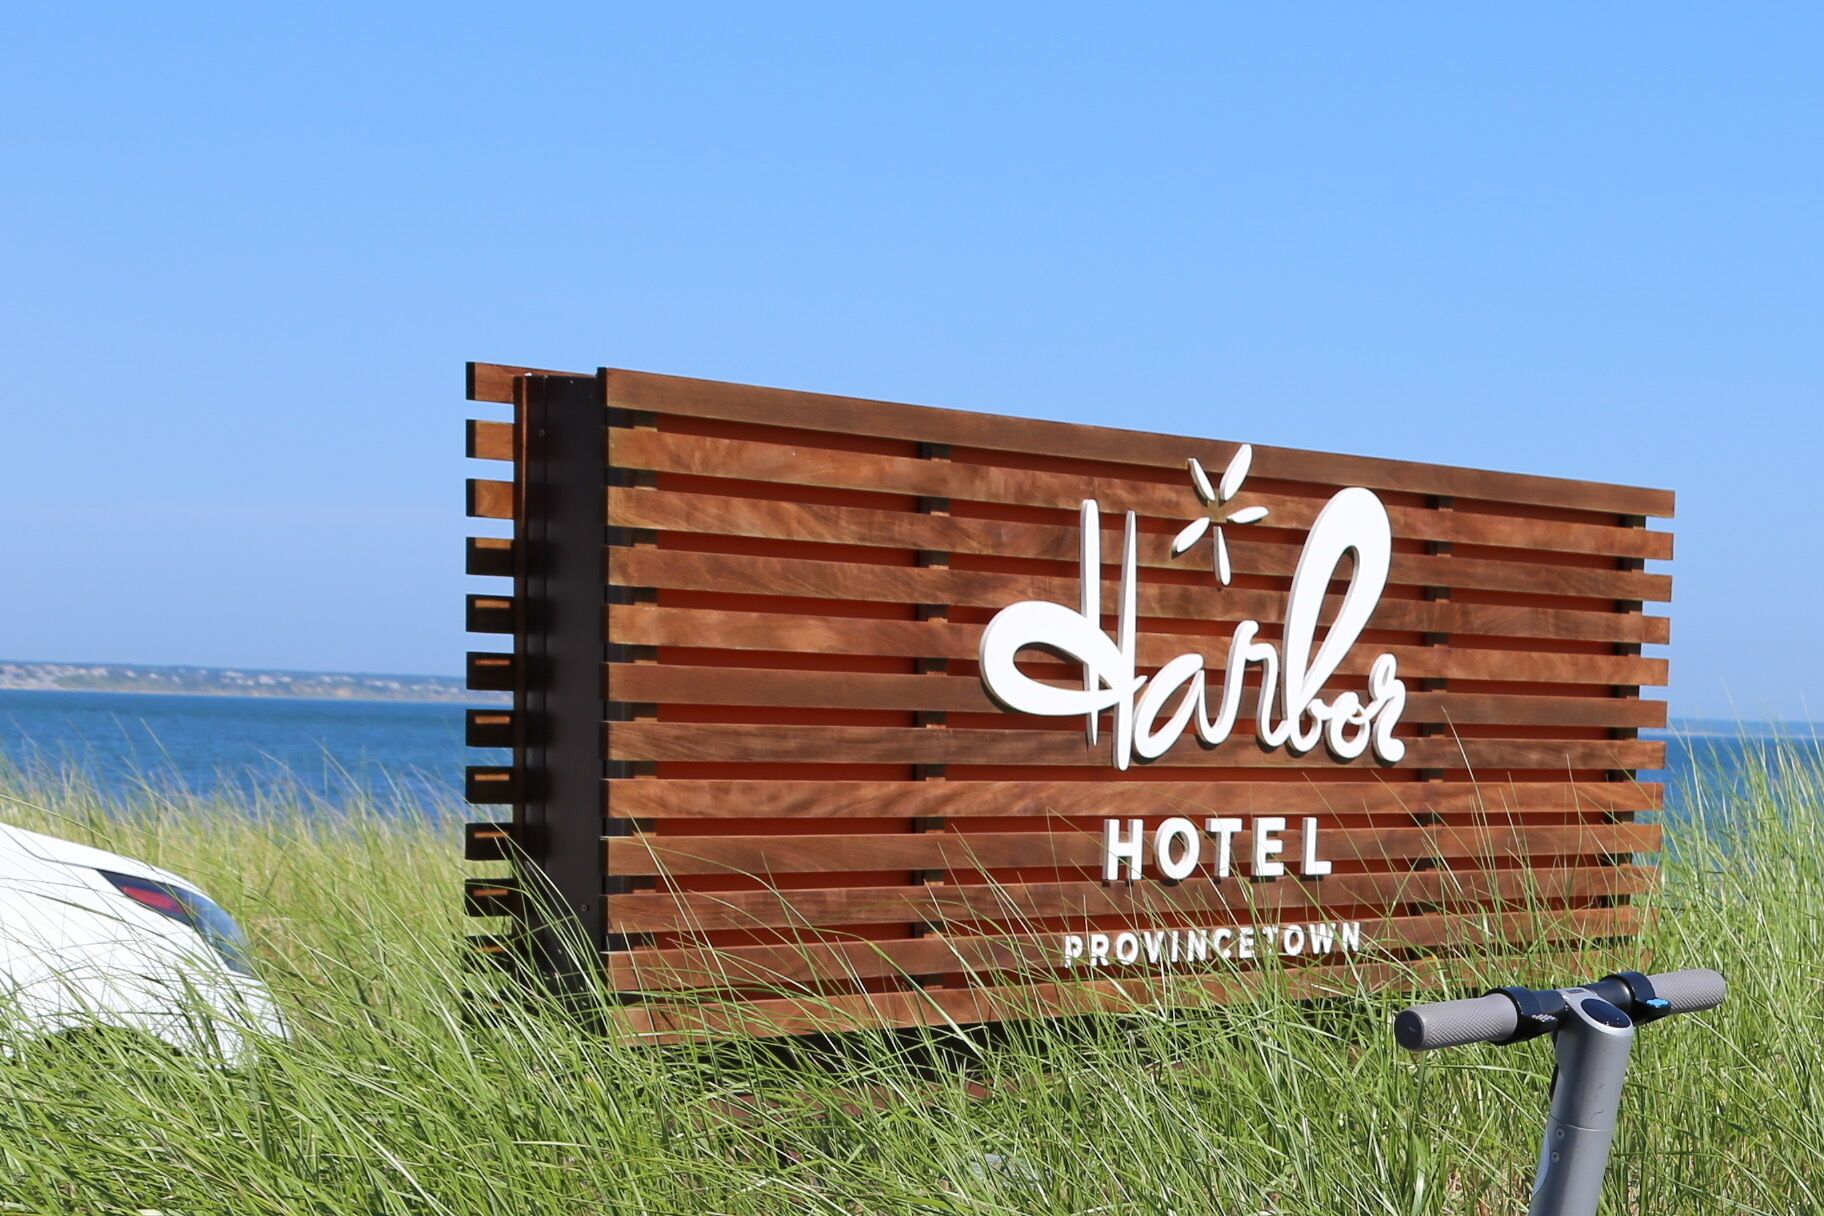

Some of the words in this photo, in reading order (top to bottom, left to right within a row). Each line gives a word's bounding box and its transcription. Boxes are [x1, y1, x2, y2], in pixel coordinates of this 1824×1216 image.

[979, 486, 1406, 771] Harbor
[1103, 817, 1332, 881] HOTEL
[1064, 921, 1361, 968] PROVINCETOWN
